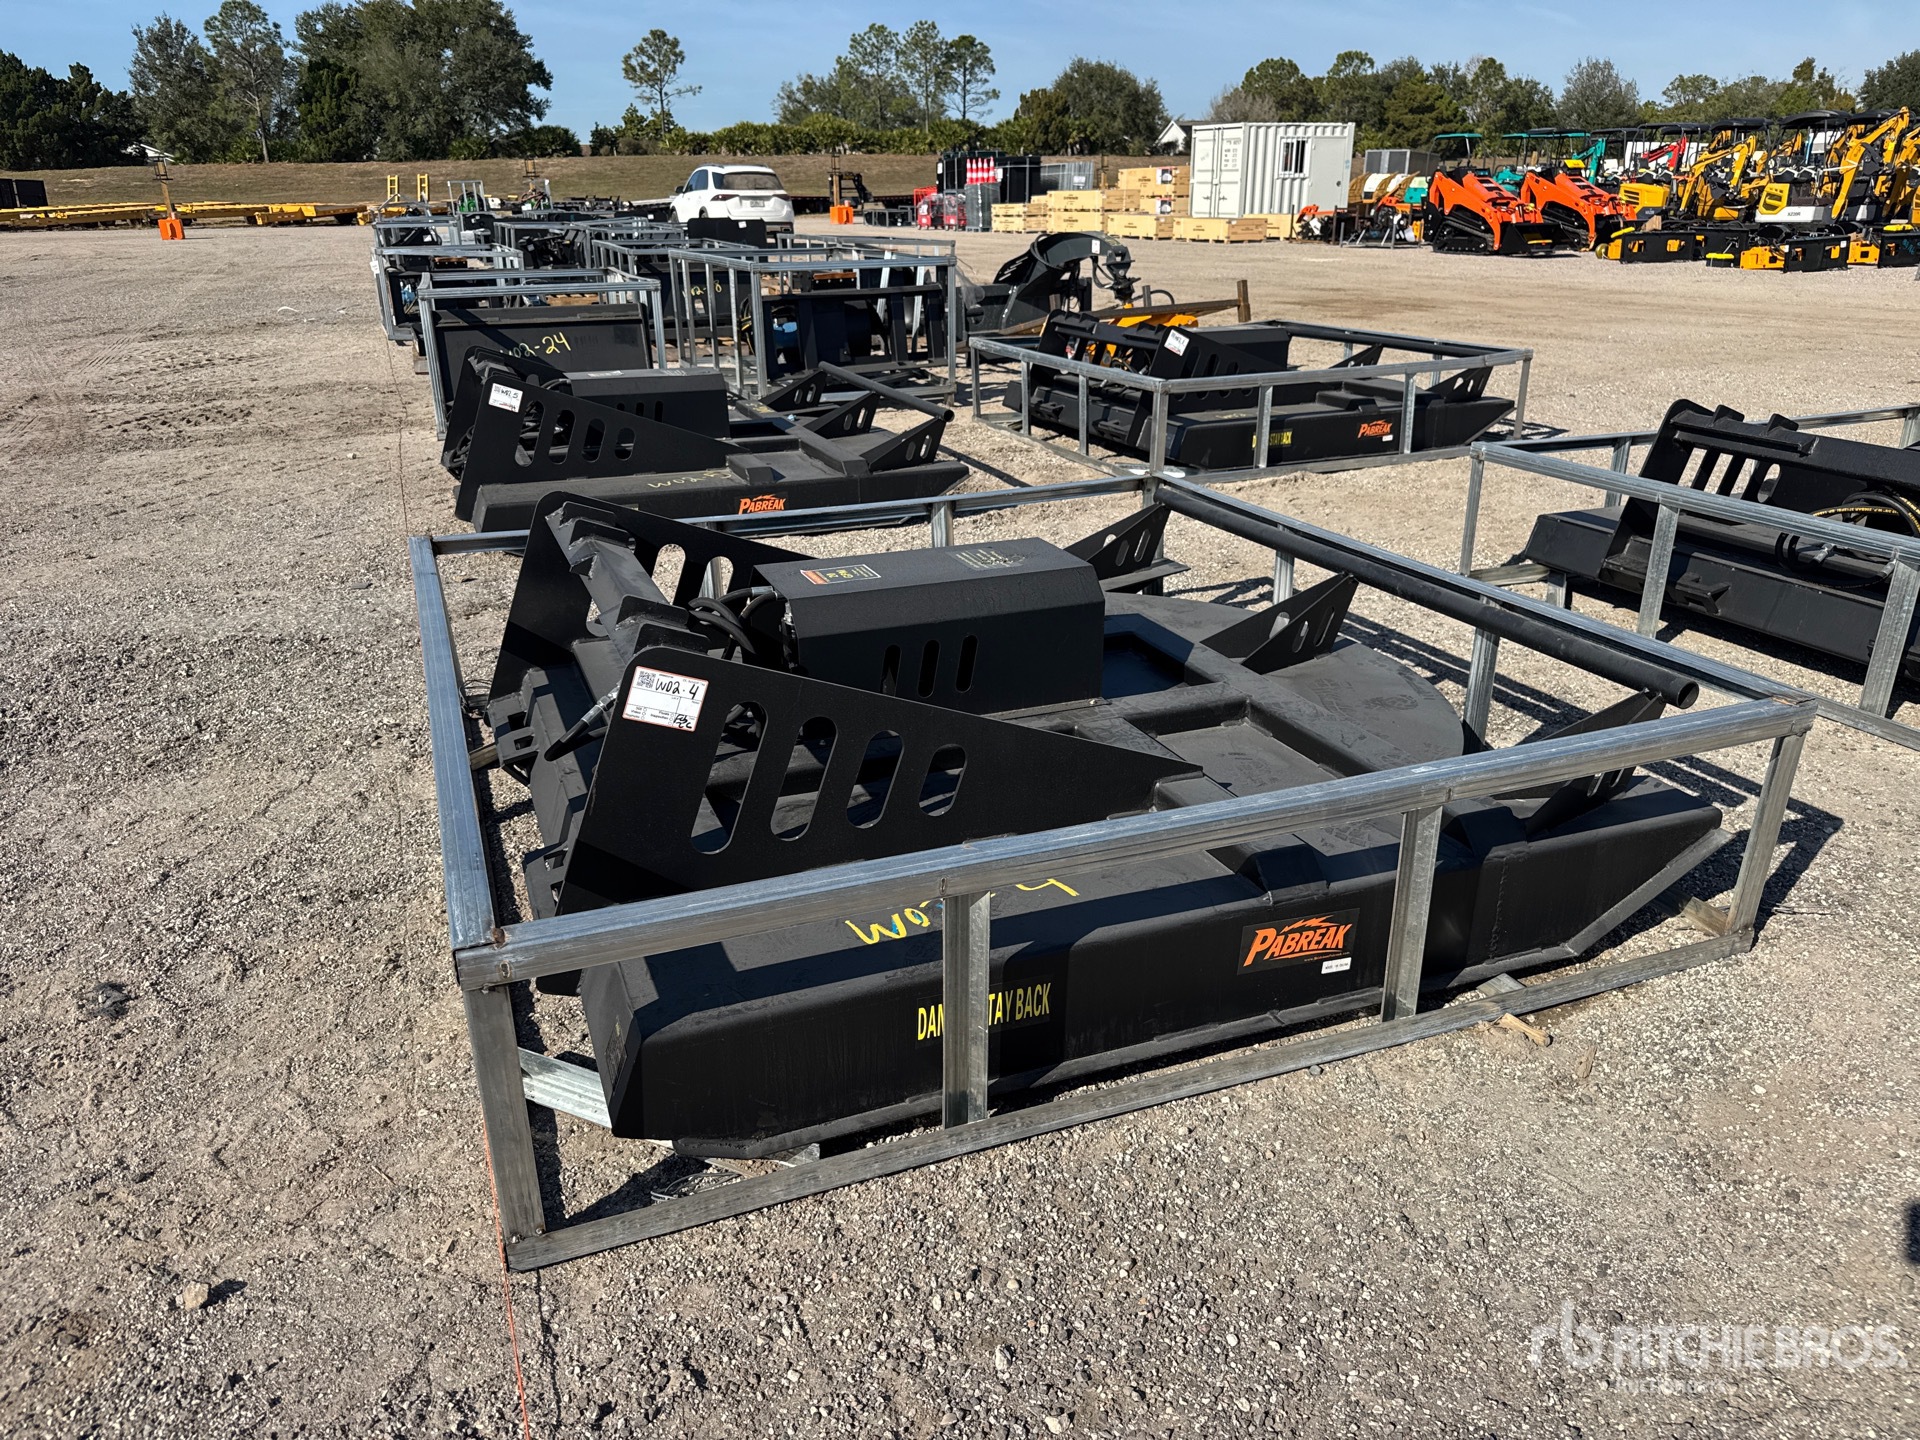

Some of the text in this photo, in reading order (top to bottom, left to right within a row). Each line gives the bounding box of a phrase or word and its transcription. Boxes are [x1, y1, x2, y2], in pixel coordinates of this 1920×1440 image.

[500, 332, 571, 358] 02-24
[1357, 422, 1393, 439] PABREAK
[738, 498, 786, 515] PABREAK
[1243, 923, 1353, 967] PABREAK
[917, 982, 1051, 1041] DAN TAY BACK
